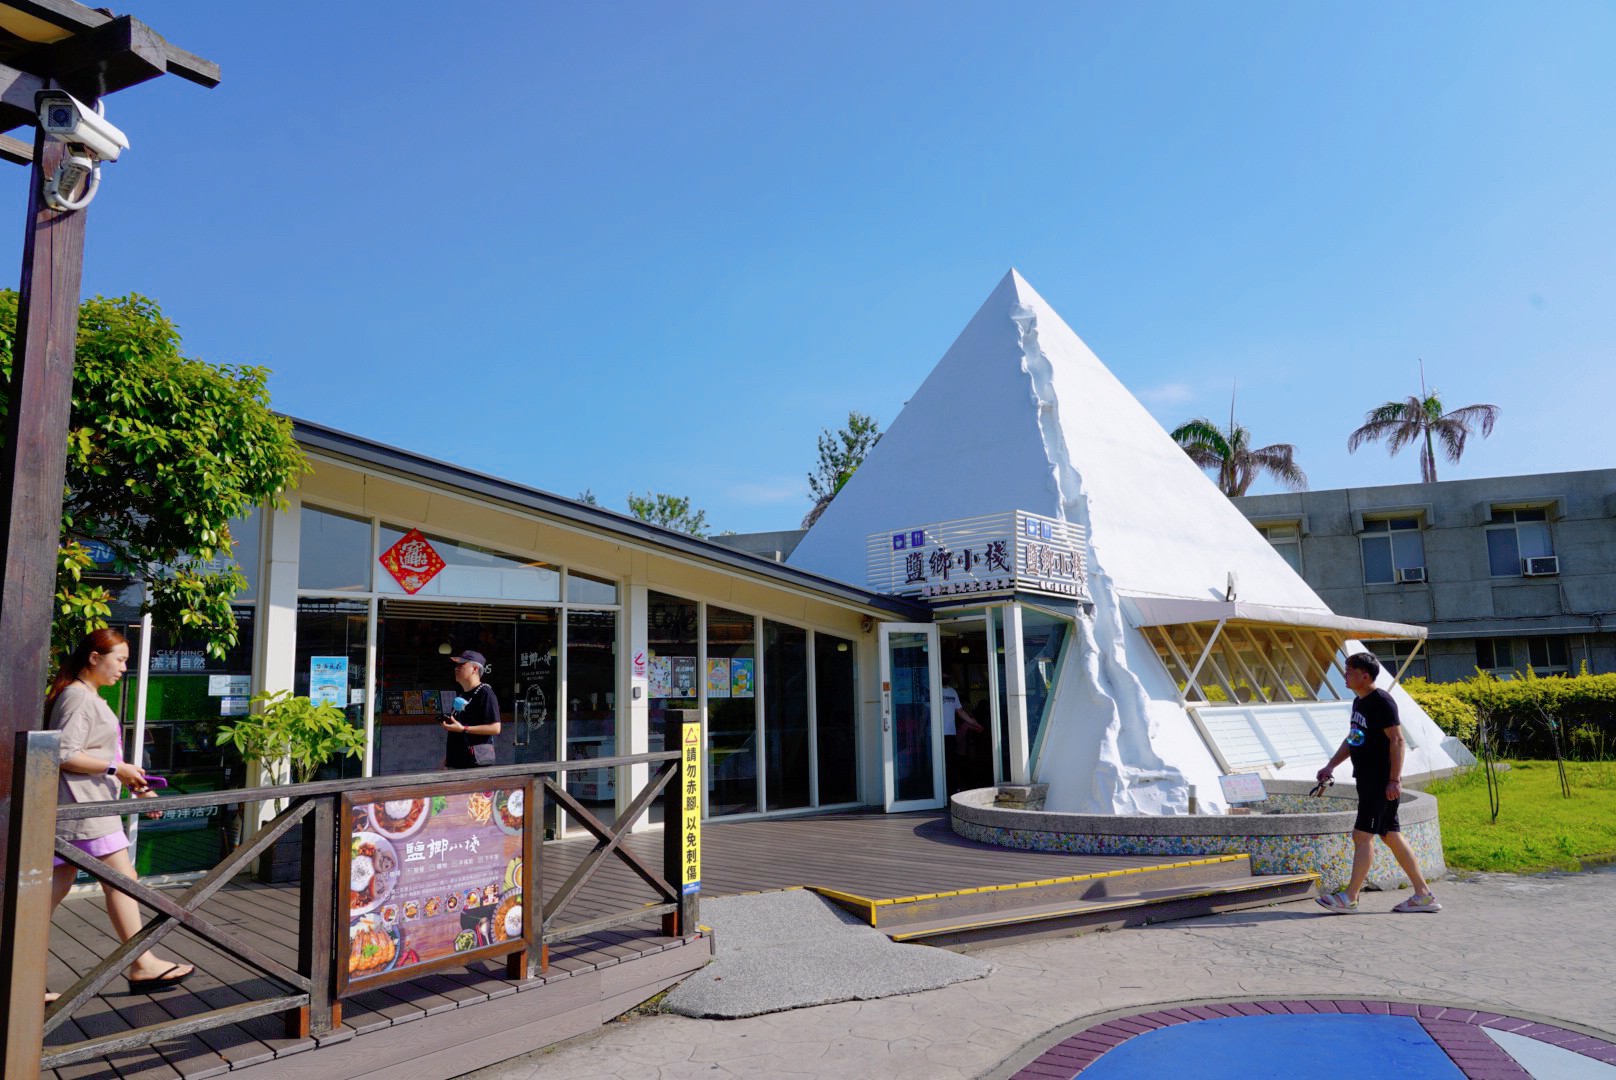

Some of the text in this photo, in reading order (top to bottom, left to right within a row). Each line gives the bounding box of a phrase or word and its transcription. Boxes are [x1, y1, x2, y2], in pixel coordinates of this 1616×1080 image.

[904, 539, 1012, 585] 鹽鄉小棧
[1025, 542, 1085, 584] 鹽鄉小棧
[686, 747, 697, 812] 請勿赤腳
[686, 815, 697, 882] 以免刺傷
